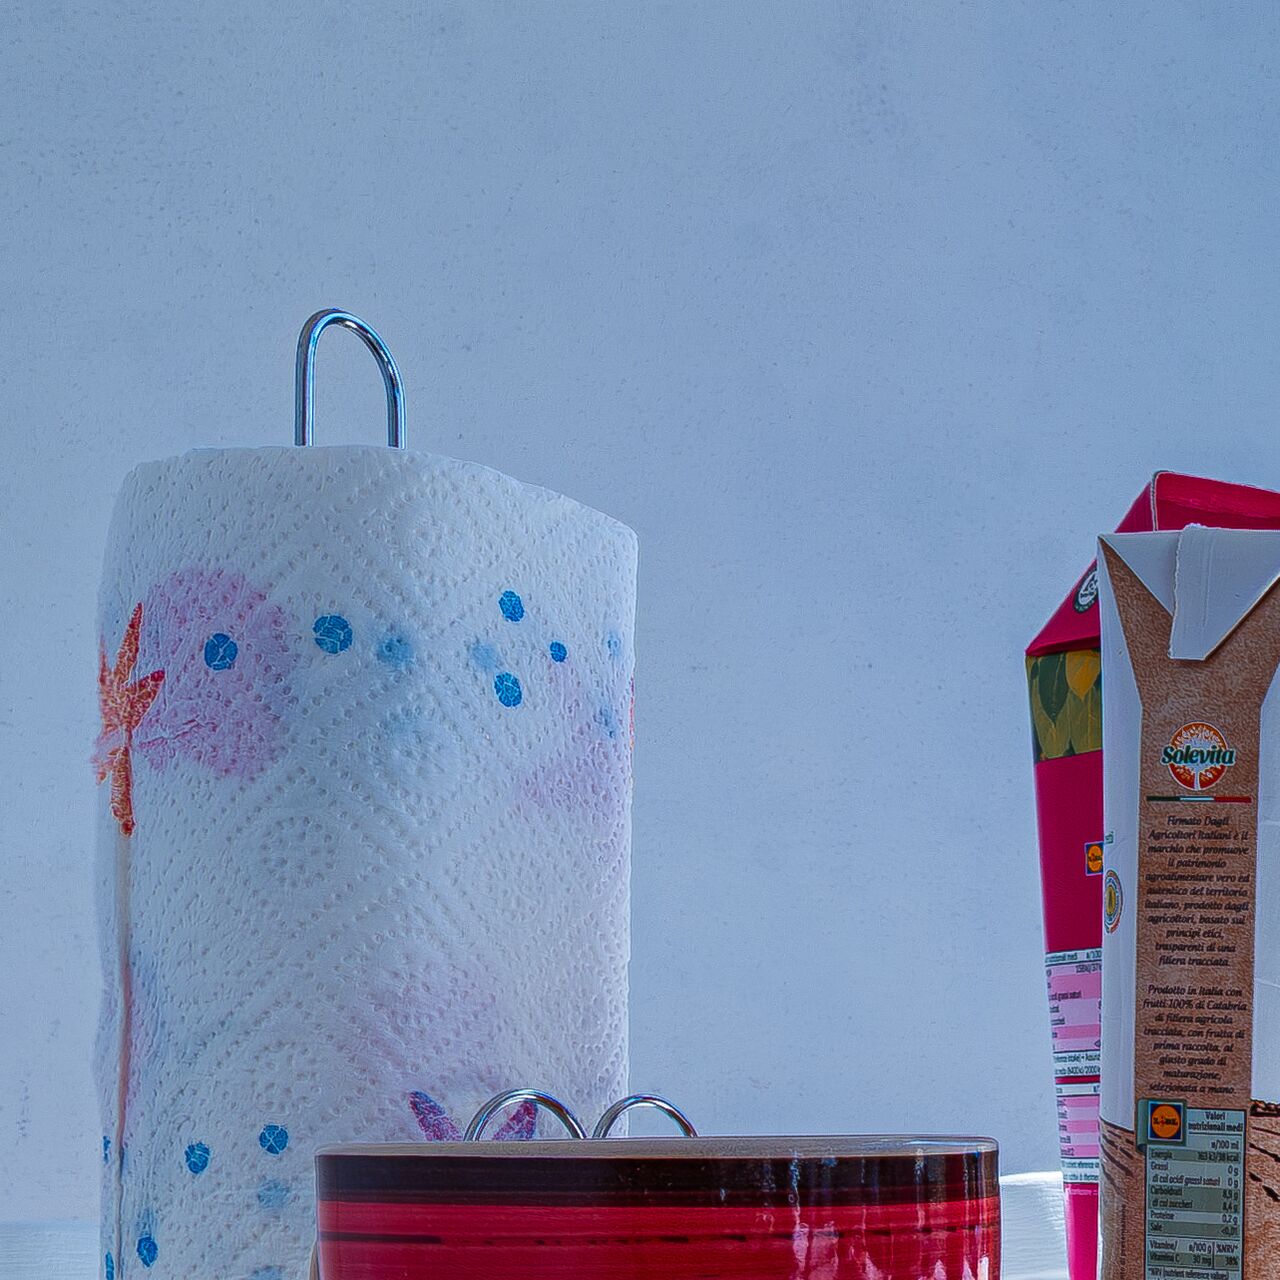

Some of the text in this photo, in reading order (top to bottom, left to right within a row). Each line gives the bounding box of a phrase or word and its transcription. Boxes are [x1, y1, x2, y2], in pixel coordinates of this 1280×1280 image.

[1162, 745, 1235, 765] Solevita
[1167, 816, 1229, 827] Firmato Dagli
[1148, 829, 1196, 841] Agricoltori
[1198, 830, 1231, 840] Italiani
[1241, 831, 1249, 840] il
[1147, 843, 1249, 855] marchio che promuove
[1176, 858, 1227, 869] patrimonio
[1216, 874, 1236, 882] vero
[1147, 886, 1248, 897] autentico del territorio
[1183, 900, 1223, 911] prodotto
[1224, 902, 1249, 912] dagli
[1199, 915, 1229, 924] basato
[1206, 943, 1215, 952] di
[1158, 955, 1186, 967] filiera
[1148, 984, 1242, 997] Prodotto in Italia con
[1143, 998, 1247, 1011] frutti 100% di Calabria
[1166, 1012, 1193, 1024] filiera
[1195, 1014, 1233, 1025] agricola
[1188, 1029, 1203, 1037] con
[1205, 1028, 1233, 1039] frutta
[1235, 1030, 1245, 1039] di
[1153, 1041, 1180, 1051] prima
[1223, 1043, 1234, 1052] al
[1159, 1054, 1227, 1066] giusto grado di
[1205, 1111, 1226, 1120] Valori
[1226, 1123, 1243, 1132] medi
[1228, 1165, 1233, 1174] 0
[1234, 1167, 1239, 1177] g
[1228, 1178, 1233, 1187] 0
[1234, 1180, 1239, 1189] g
[1234, 1191, 1239, 1201] g
[1234, 1204, 1238, 1213] g
[1233, 1217, 1238, 1226] g
